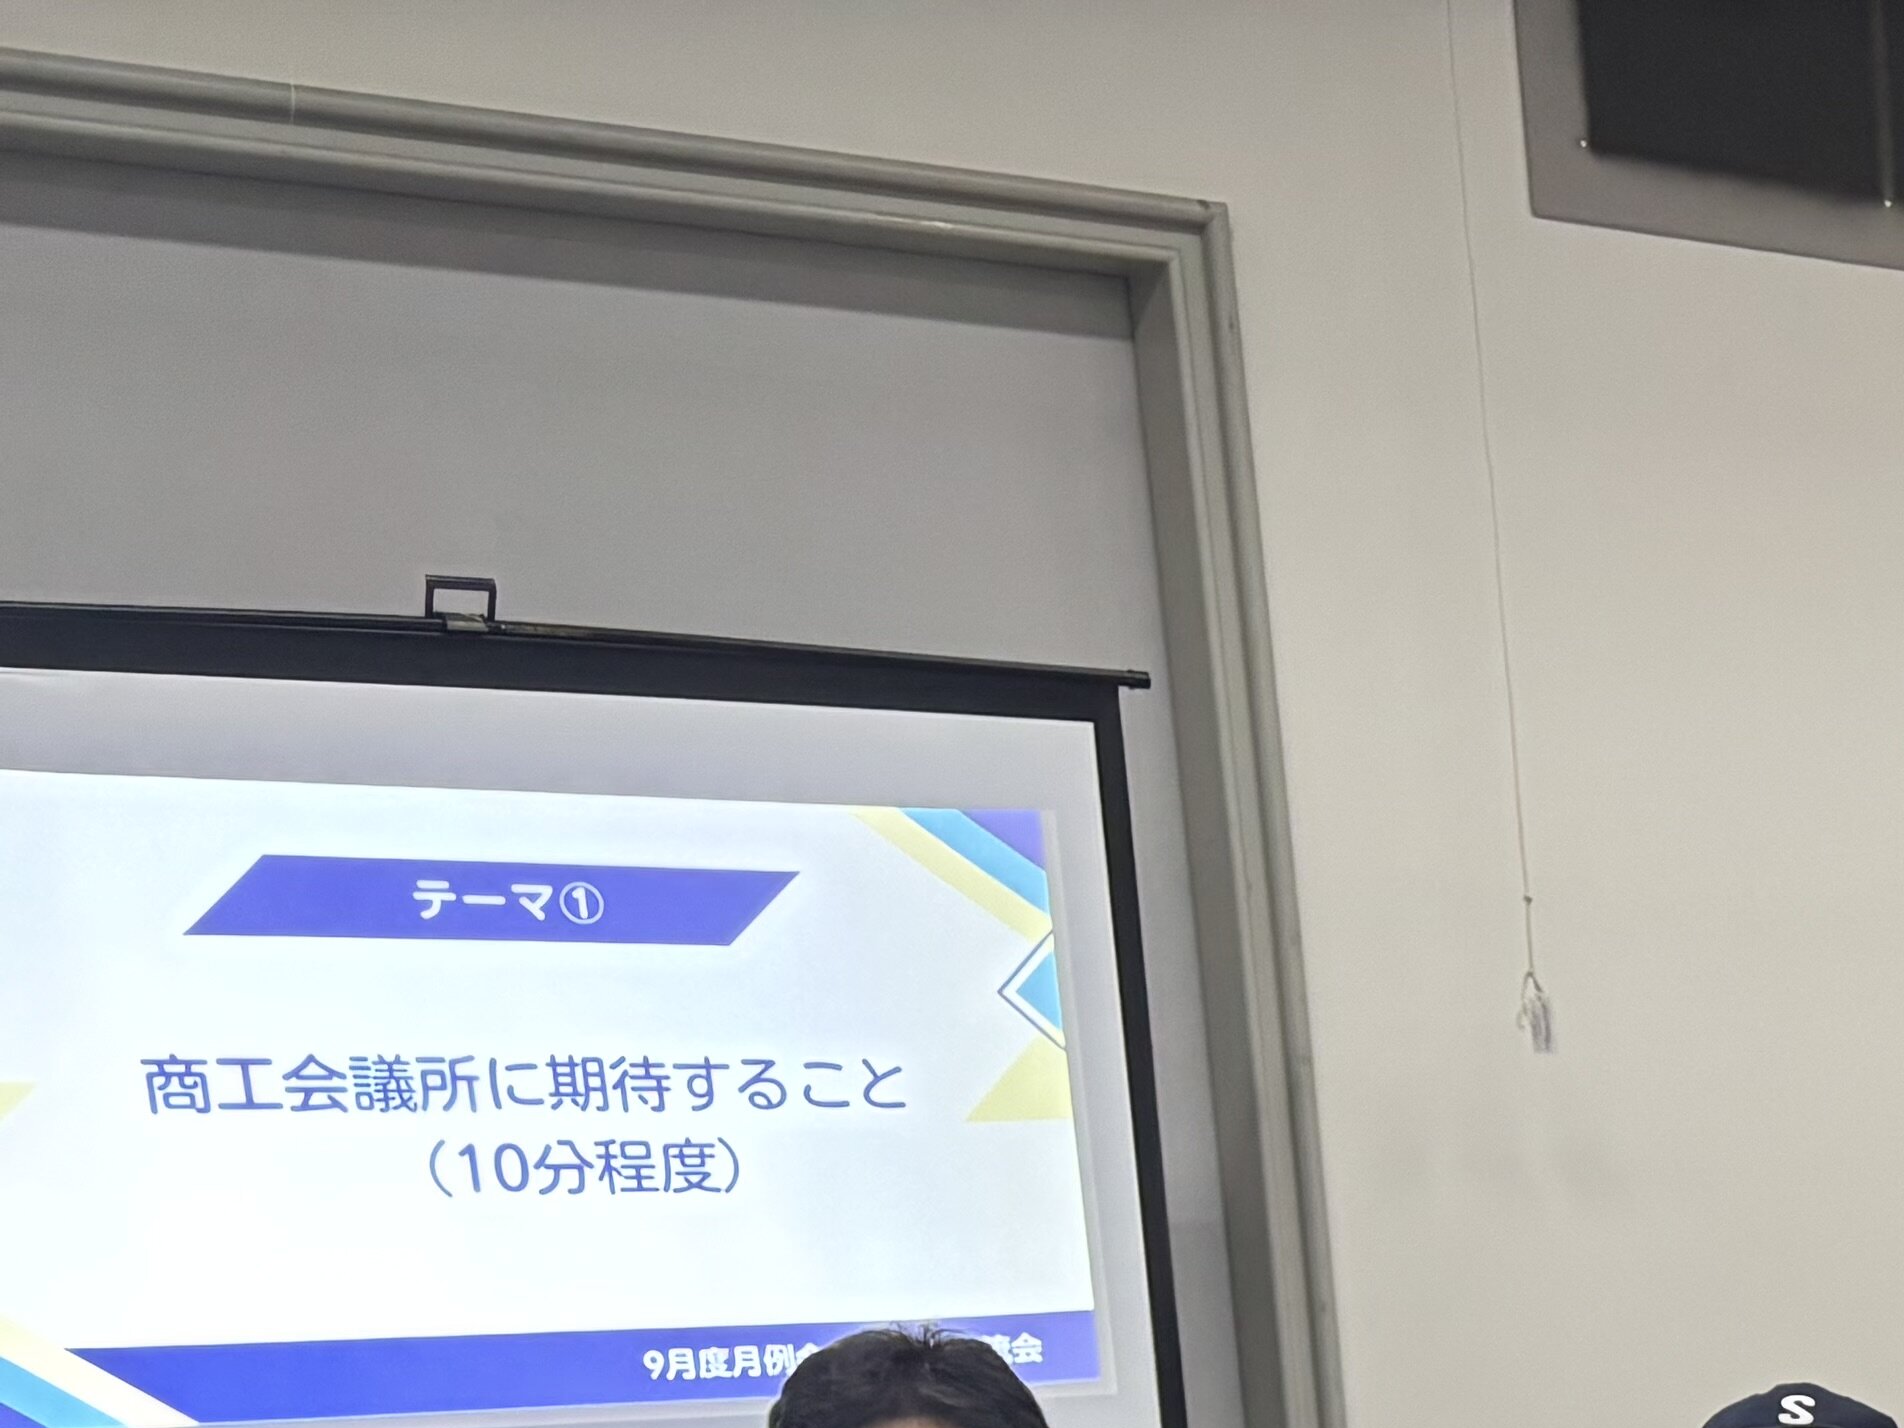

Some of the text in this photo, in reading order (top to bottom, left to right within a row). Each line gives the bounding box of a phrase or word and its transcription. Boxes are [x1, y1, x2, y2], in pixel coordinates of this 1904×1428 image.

[413, 879, 604, 924] テーマ①
[140, 1054, 906, 1114] 商工会議所に期待すること
[1778, 1394, 1816, 1425] S
